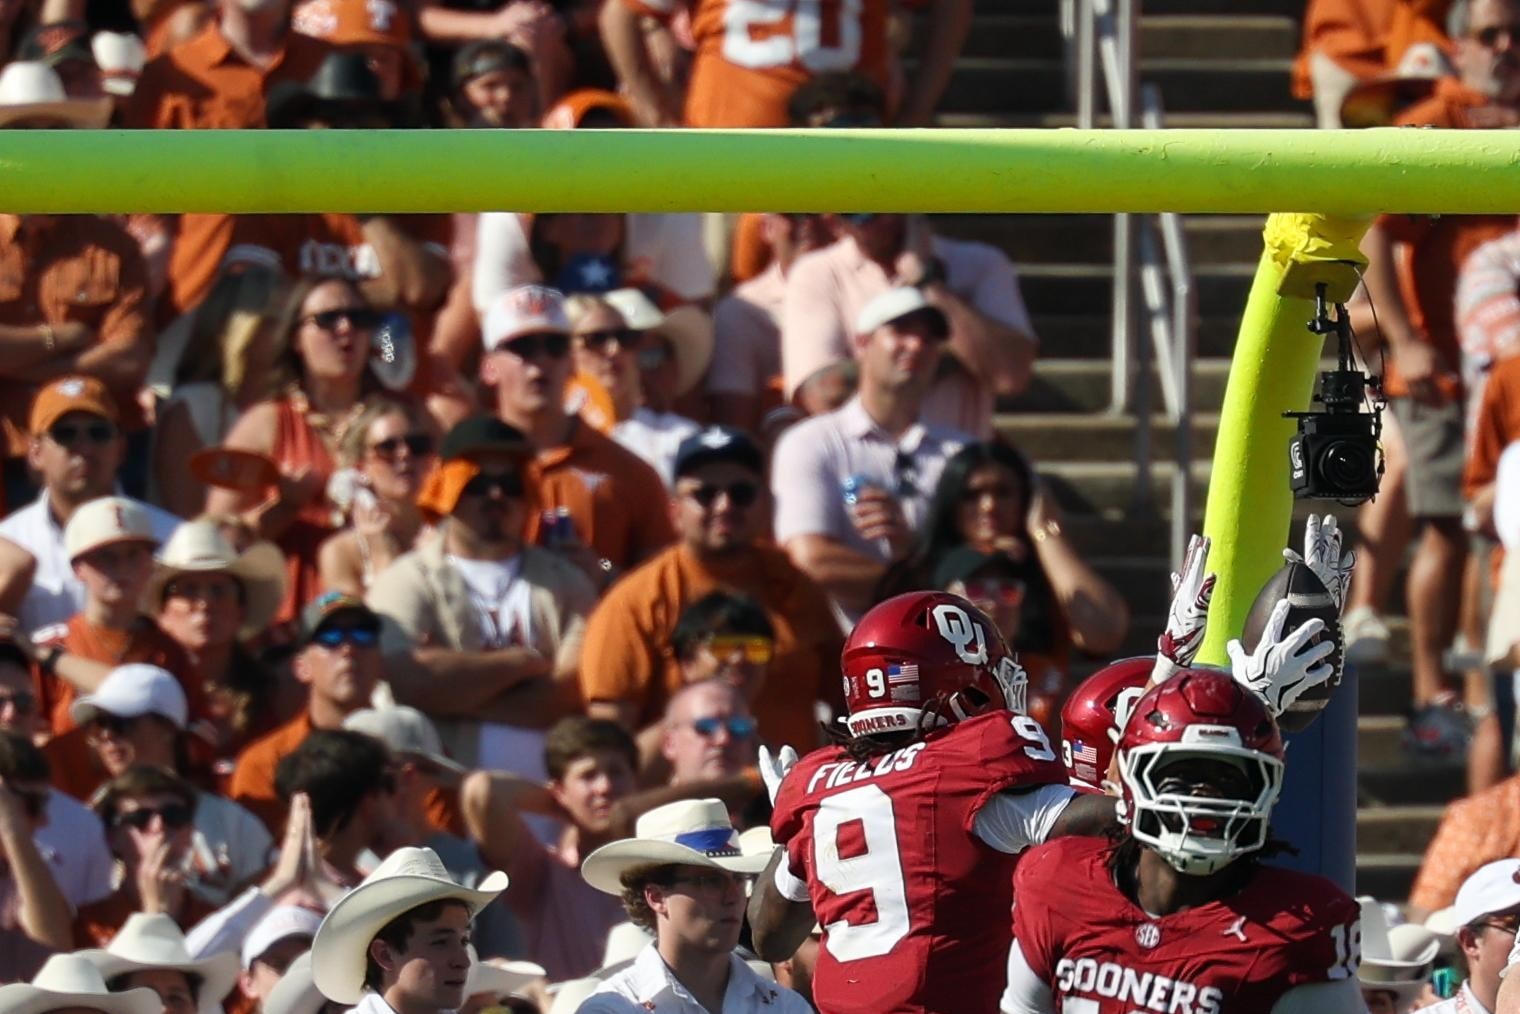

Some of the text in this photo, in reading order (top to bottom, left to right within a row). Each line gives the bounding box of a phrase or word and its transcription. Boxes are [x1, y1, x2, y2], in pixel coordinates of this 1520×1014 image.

[932, 604, 989, 665] OU
[866, 668, 886, 698] 9
[1011, 715, 1056, 761] 9
[806, 742, 927, 794] FIELDS
[813, 784, 910, 963] 9
